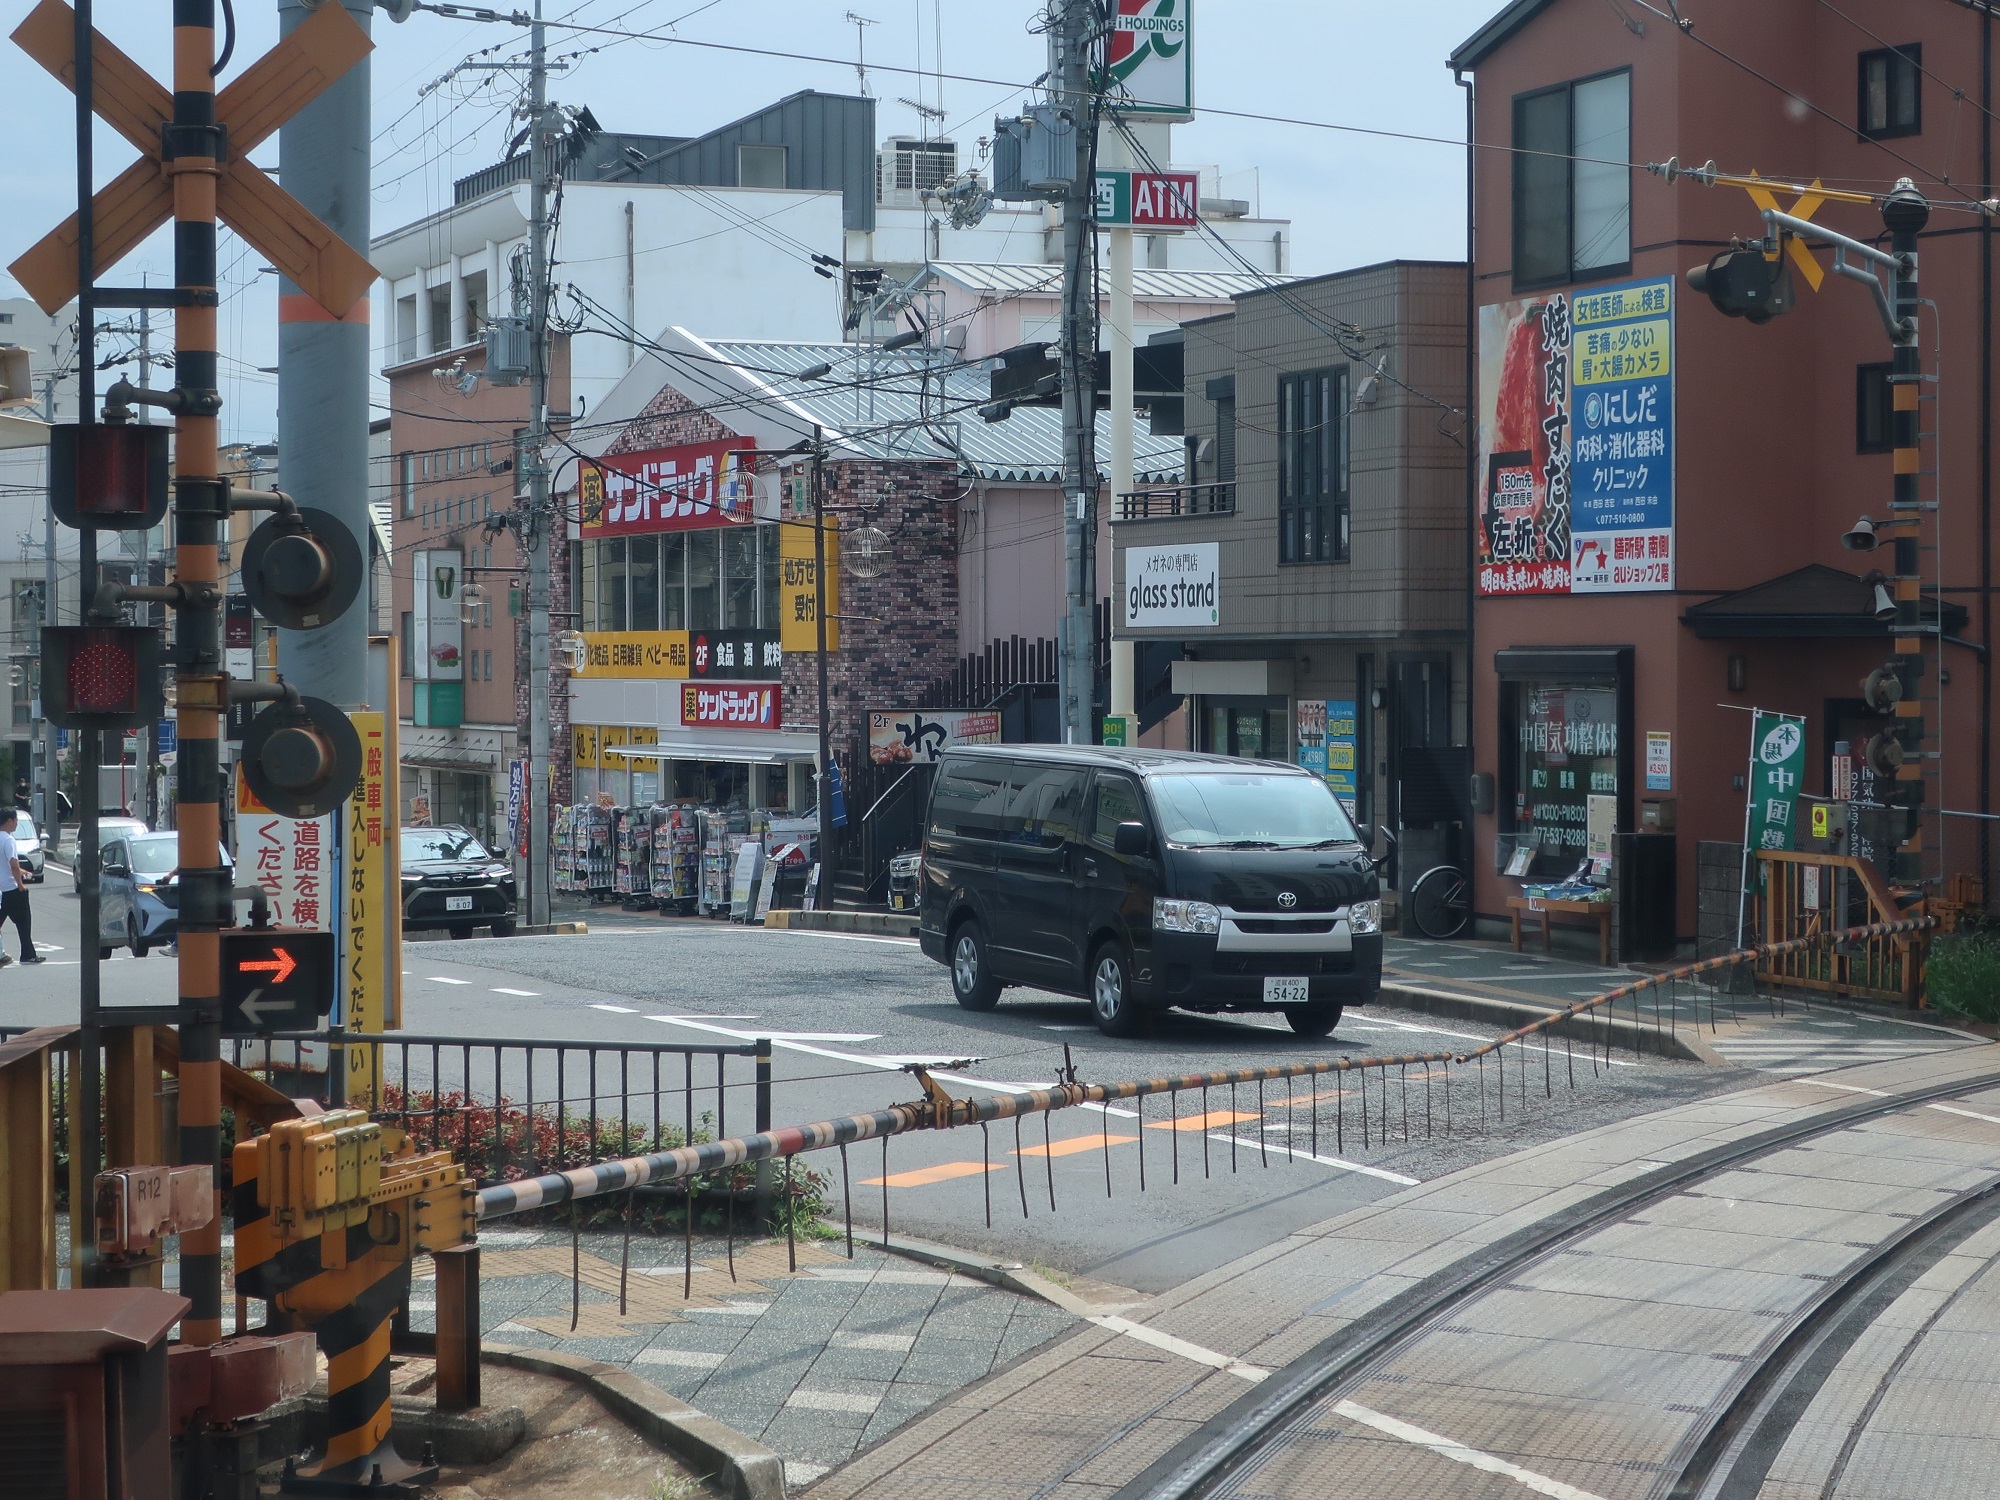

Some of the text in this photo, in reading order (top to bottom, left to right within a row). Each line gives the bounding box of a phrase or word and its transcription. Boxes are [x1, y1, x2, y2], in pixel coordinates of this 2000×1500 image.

[1125, 16, 1184, 32] HOLDINGS
[1134, 179, 1194, 220] ATM
[1577, 287, 1666, 323] 女性医師による検査
[1587, 327, 1655, 356] 苦痛の少ない
[1582, 350, 1660, 381] 胃・大腸カメラ
[1604, 384, 1658, 427] にしだ
[1576, 427, 1666, 463] 内科・消化器科
[606, 455, 714, 524] サンドラッグ
[1500, 471, 1533, 491] 150m先
[1592, 464, 1649, 493] クリニック
[1493, 515, 1533, 558] 左折
[1614, 535, 1669, 561] 膳所駅 南側
[785, 558, 816, 587] 処方せ
[1145, 553, 1198, 573] メガネの専門店
[794, 593, 816, 623] 受付
[1129, 571, 1215, 620] glass stand
[587, 644, 609, 666] 化粧品
[612, 644, 643, 666] 日用雑貨
[645, 643, 686, 667] ベビー用品
[695, 641, 782, 667] 2F 食品 酒 飲料
[686, 690, 759, 722] 薬 サンドラッグ
[873, 713, 891, 728] 2F
[366, 731, 382, 848] 一般車両
[1532, 826, 1586, 847] 077-537-9288
[292, 820, 321, 931] 道路を横
[351, 774, 366, 1073] 進入しないでください
[1273, 988, 1307, 1000] 54-22
[137, 1176, 161, 1202] R12
